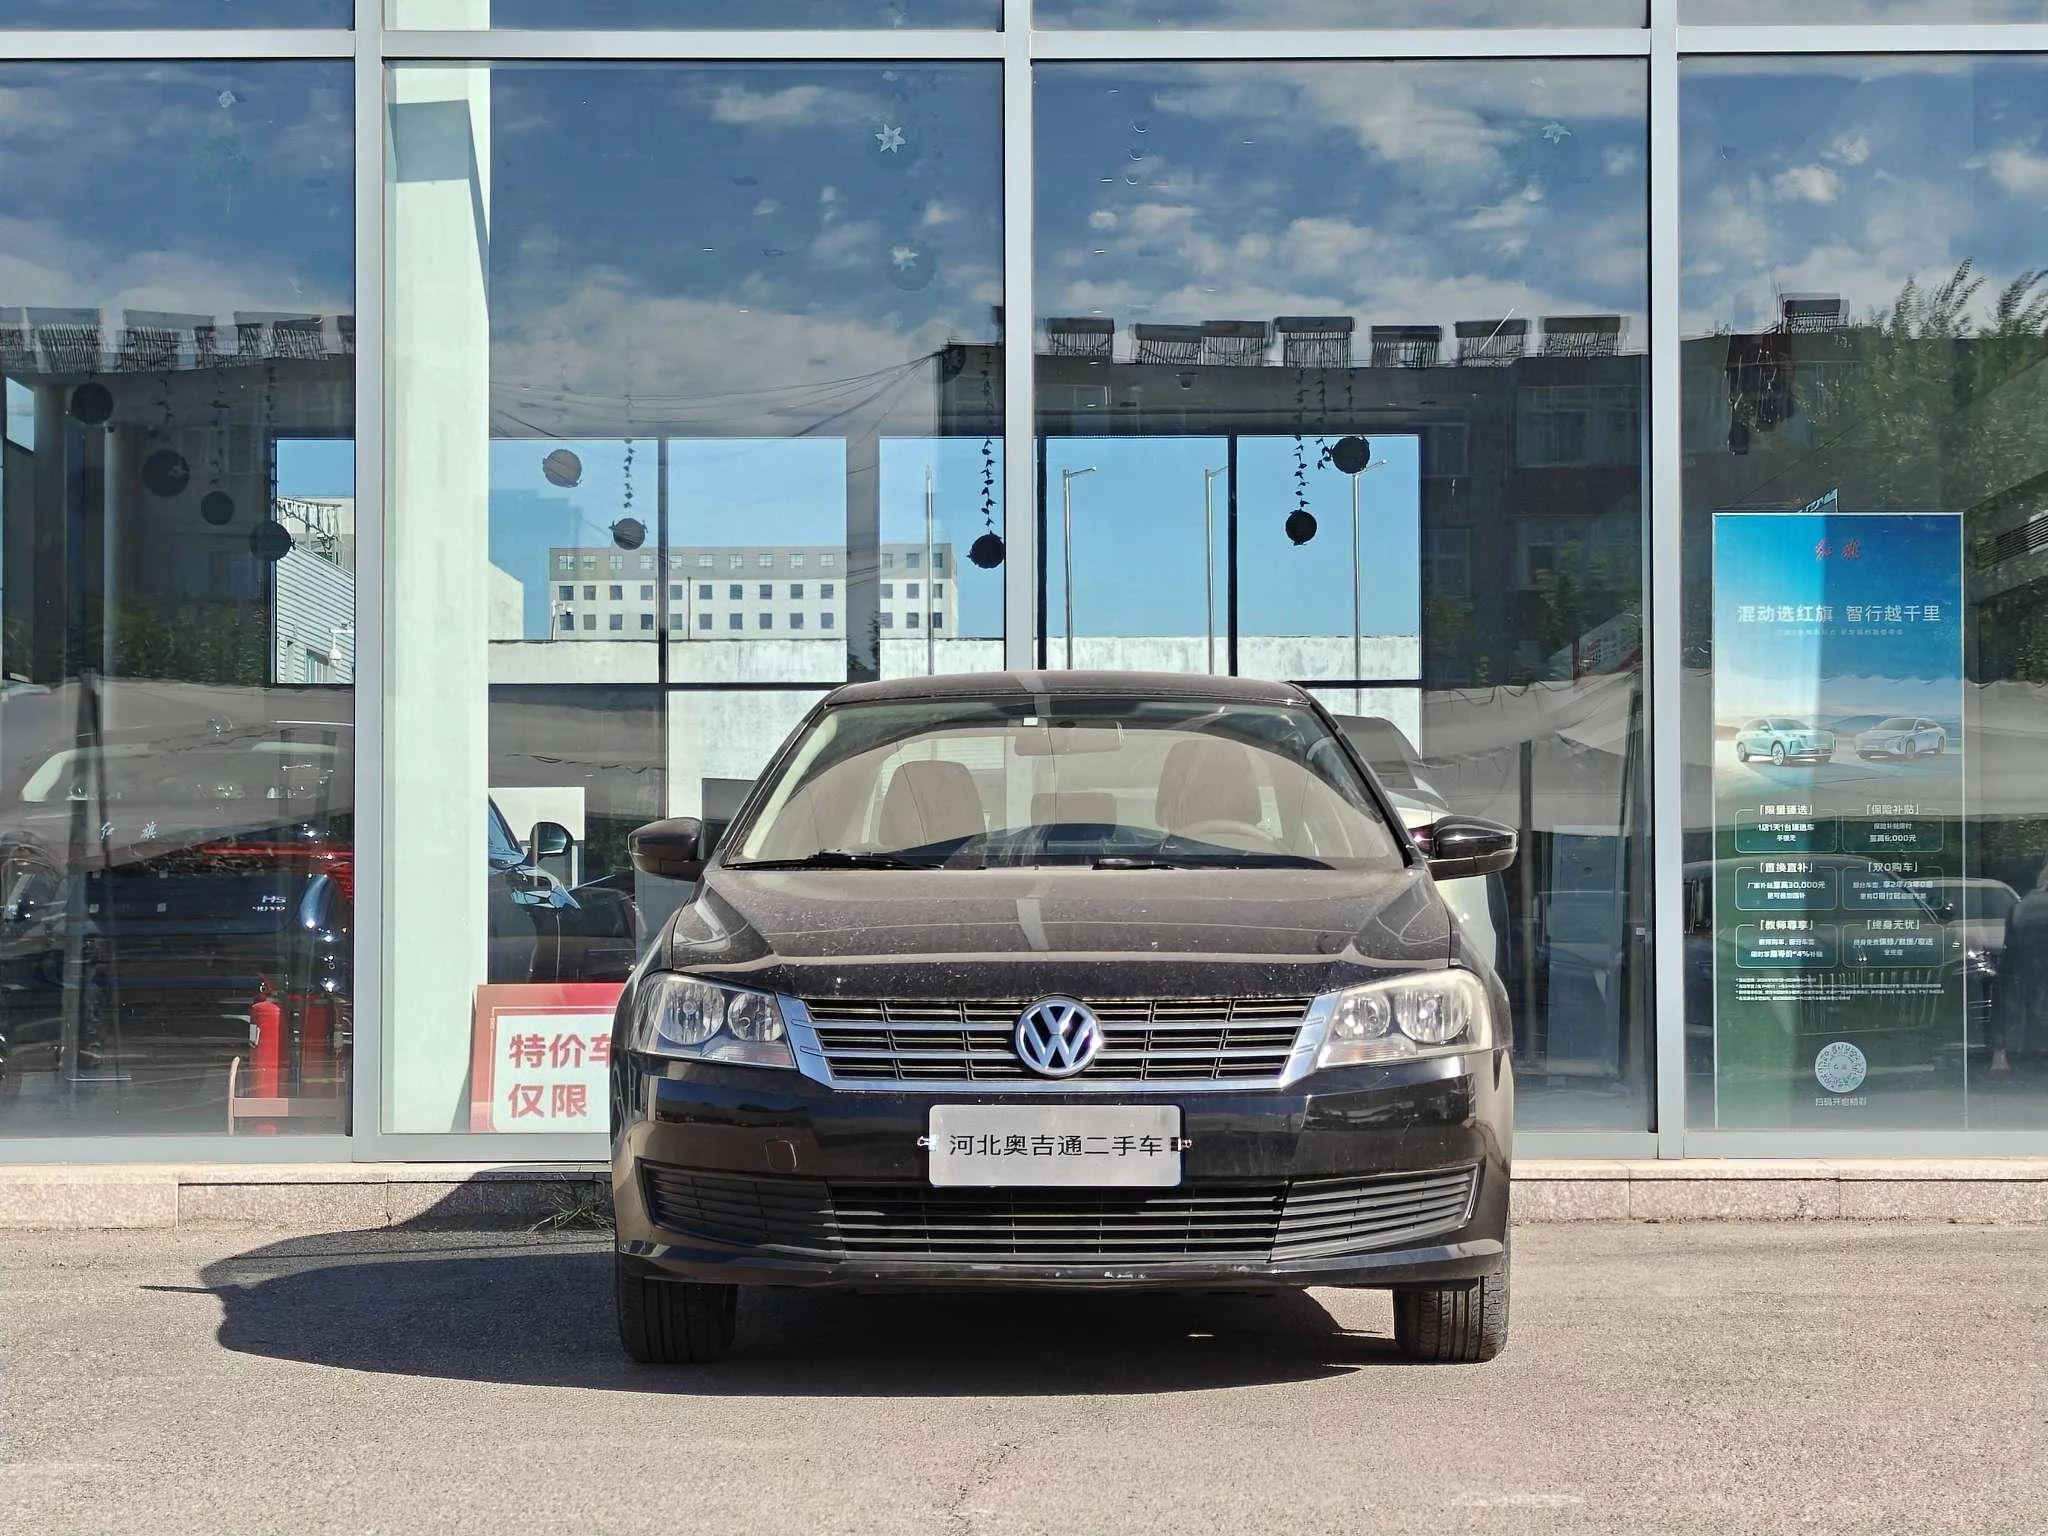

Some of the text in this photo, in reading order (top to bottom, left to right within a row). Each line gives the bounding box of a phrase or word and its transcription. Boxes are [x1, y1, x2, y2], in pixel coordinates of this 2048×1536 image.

[1738, 605, 1941, 623] 混动选红旗 智行越千里
[507, 1083, 588, 1119] 仅限
[949, 1134, 1164, 1157] 河北奥吉通二手车
